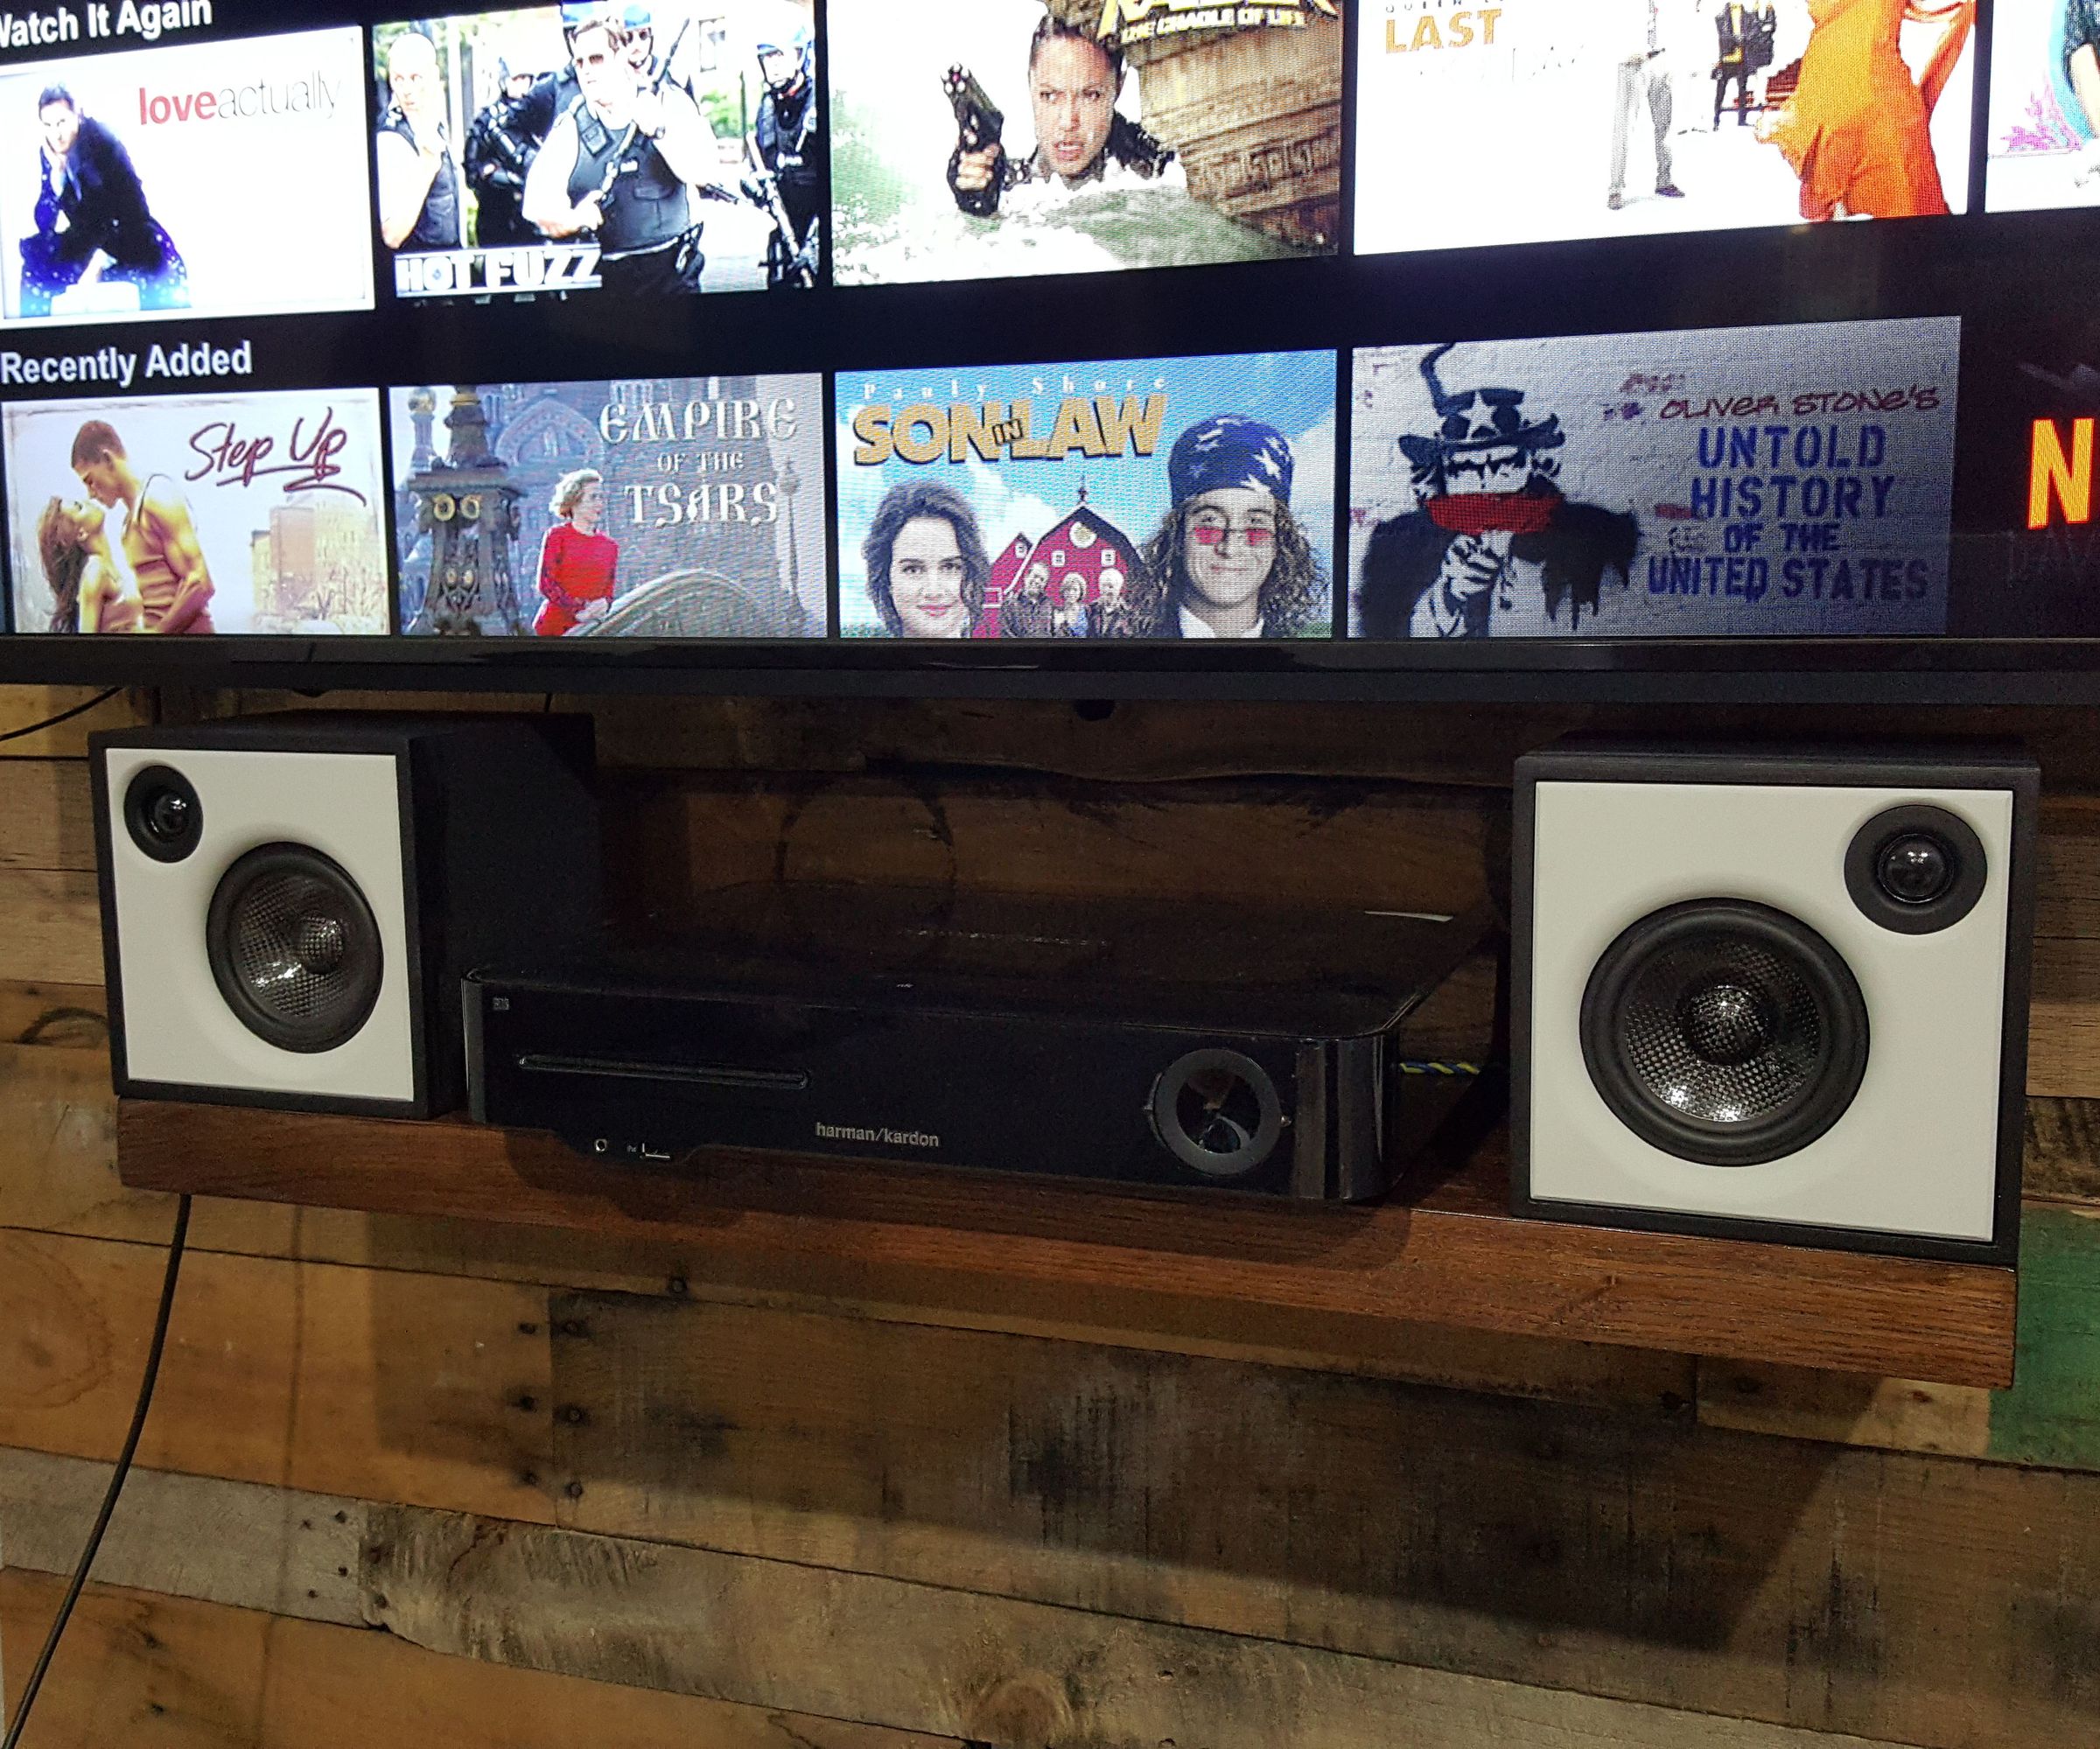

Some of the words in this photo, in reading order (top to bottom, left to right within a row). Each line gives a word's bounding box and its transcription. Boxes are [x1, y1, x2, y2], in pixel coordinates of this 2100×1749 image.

[88, 3, 110, 38] It
[116, 0, 213, 41] Again
[1385, 9, 1502, 53] LAST
[396, 252, 475, 293] HOT
[485, 248, 602, 290] FUZZ
[1, 350, 137, 388] Recently
[144, 339, 253, 379] Added
[599, 398, 798, 444] EMPIRE
[852, 399, 1003, 465] SON
[991, 417, 1023, 447] IN
[1010, 393, 1168, 462] LAW
[1661, 395, 1780, 420] OLIVER
[185, 416, 274, 487] Step
[290, 406, 347, 482] Up
[656, 451, 687, 472] OF
[696, 451, 744, 472] THE
[1698, 424, 1889, 470] UNTOLD
[2027, 416, 2095, 530] N
[624, 480, 779, 528] TSARS
[1690, 475, 1896, 520] HISTORY
[1722, 521, 1765, 554] OF
[1779, 522, 1842, 552] THE
[1647, 556, 1769, 602] UNITED
[1782, 557, 1928, 600] STATES
[816, 1121, 940, 1148] harman/kardon
